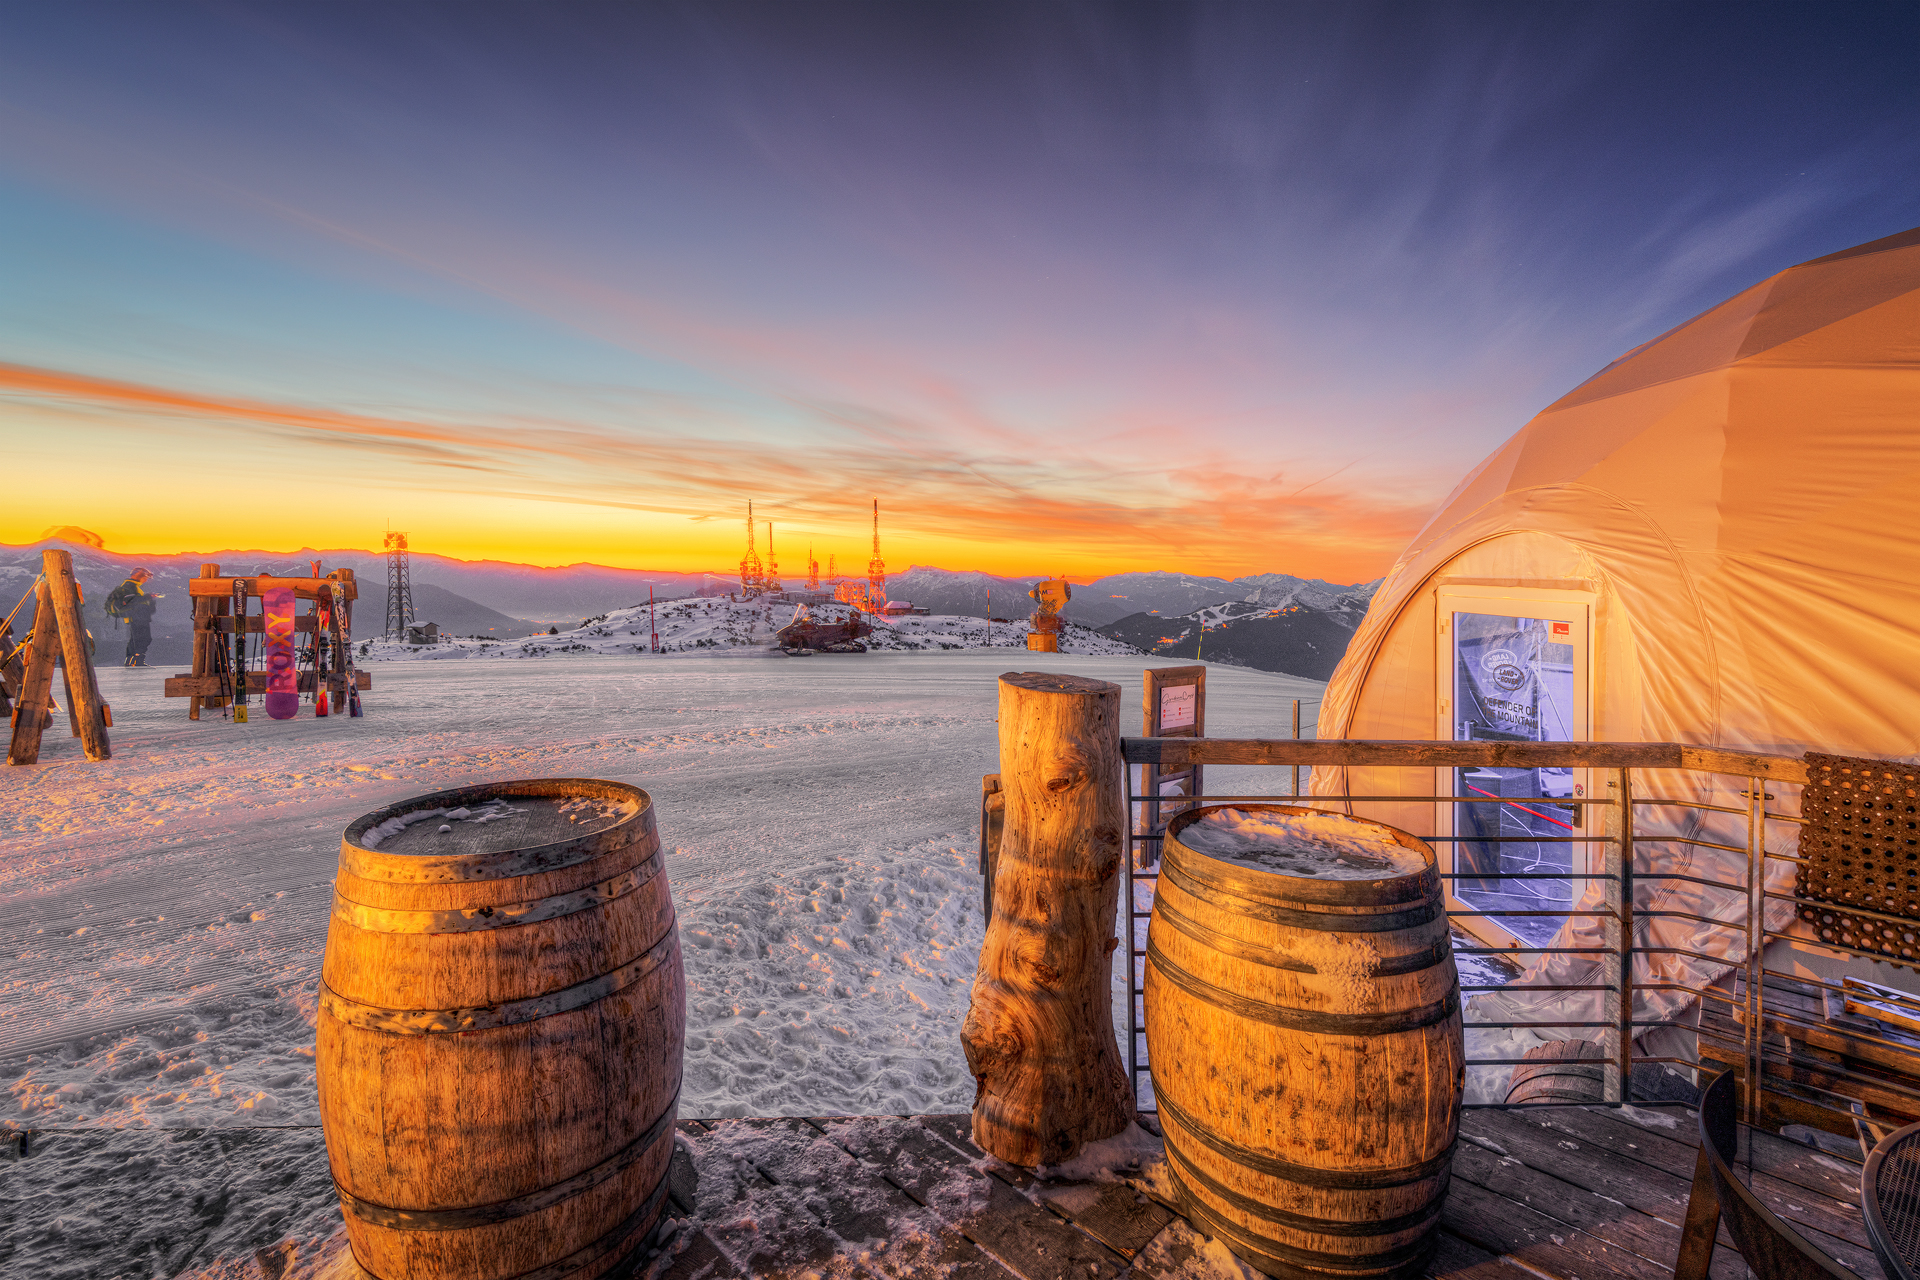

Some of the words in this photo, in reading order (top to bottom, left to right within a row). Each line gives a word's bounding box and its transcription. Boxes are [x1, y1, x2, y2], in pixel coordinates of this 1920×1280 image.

[267, 612, 293, 691] ROXY
[1499, 669, 1514, 677] LAND
[1501, 676, 1519, 685] ROVER
[1483, 696, 1524, 714] DEFENDER
[1525, 706, 1537, 717] OF
[1482, 707, 1496, 719] THE
[1497, 711, 1539, 730] MOUNTAIN
